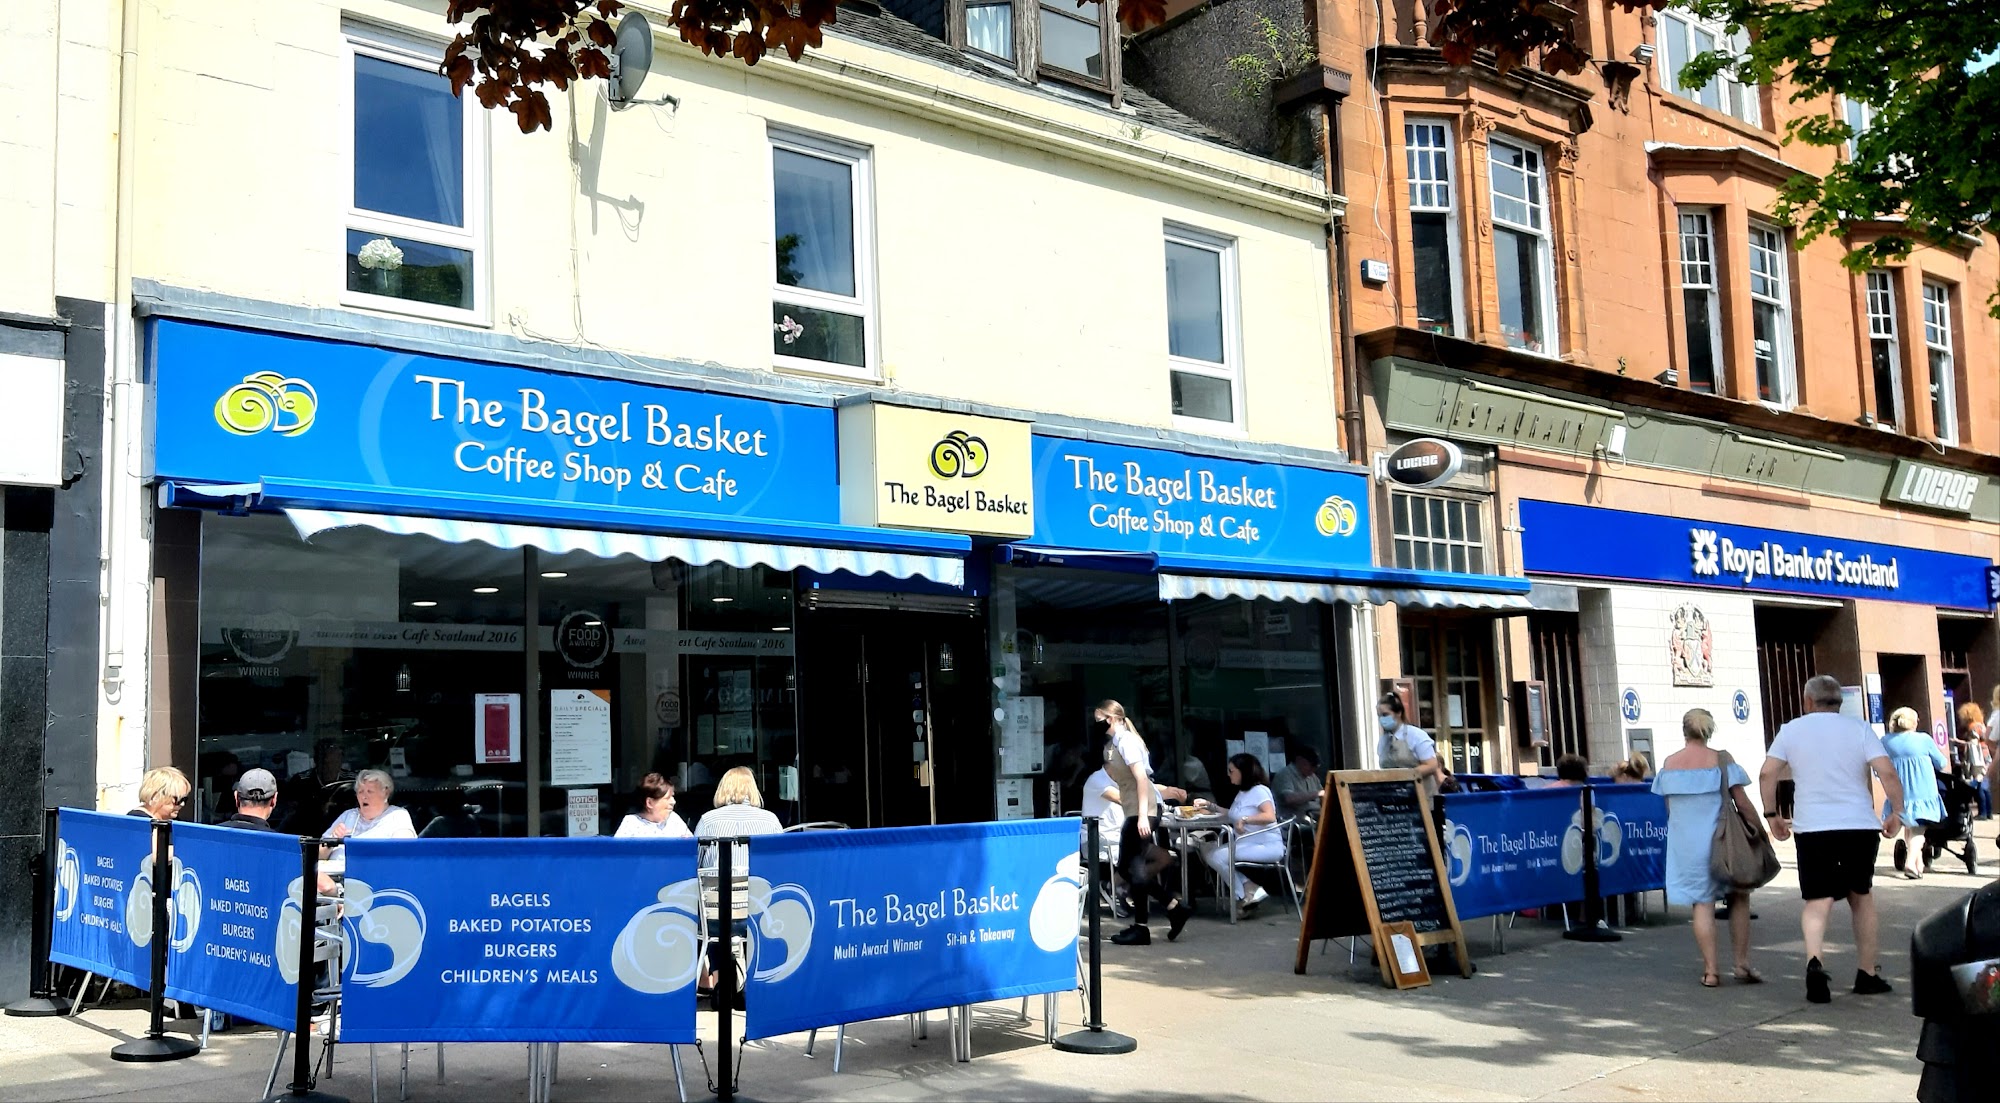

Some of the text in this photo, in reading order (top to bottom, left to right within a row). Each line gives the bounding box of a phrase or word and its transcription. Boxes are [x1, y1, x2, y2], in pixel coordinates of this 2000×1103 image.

[415, 375, 768, 457] The Bagel Basket
[454, 441, 738, 501] Coffee Shop & Cafe
[1064, 453, 1277, 509] The Bagel Basket
[884, 481, 1028, 516] The Bagel Basket
[1089, 504, 1259, 543] Coffee Shop & Cafe
[1721, 538, 1899, 588] Royal Bank of Scotland
[403, 628, 429, 644] Cafe
[433, 629, 486, 643] Scotland
[488, 630, 518, 643] 2016
[569, 629, 600, 640] FOOD
[695, 637, 716, 650] Cafe
[761, 639, 785, 649] 2016
[239, 667, 280, 677] WINNER
[568, 671, 600, 680] WINNER
[1478, 830, 1558, 856] The Bagel Basket
[97, 856, 114, 869] BAGELS
[84, 874, 100, 886] BAKED
[225, 878, 250, 894] BAGELS
[490, 893, 551, 907] BAGELS
[829, 886, 1019, 930] The Bagel Basket
[210, 898, 268, 919] BAKED POTATOES
[222, 923, 255, 940] BURGERS
[449, 918, 592, 933] BAKED POTATOES
[484, 944, 557, 958] BURGERS
[833, 927, 1015, 961] Multi Award Winner Sit-in & Takeaway
[205, 943, 271, 968] CHILDREN'S MEALS
[440, 969, 599, 984] CHILDREN'S MEALS
